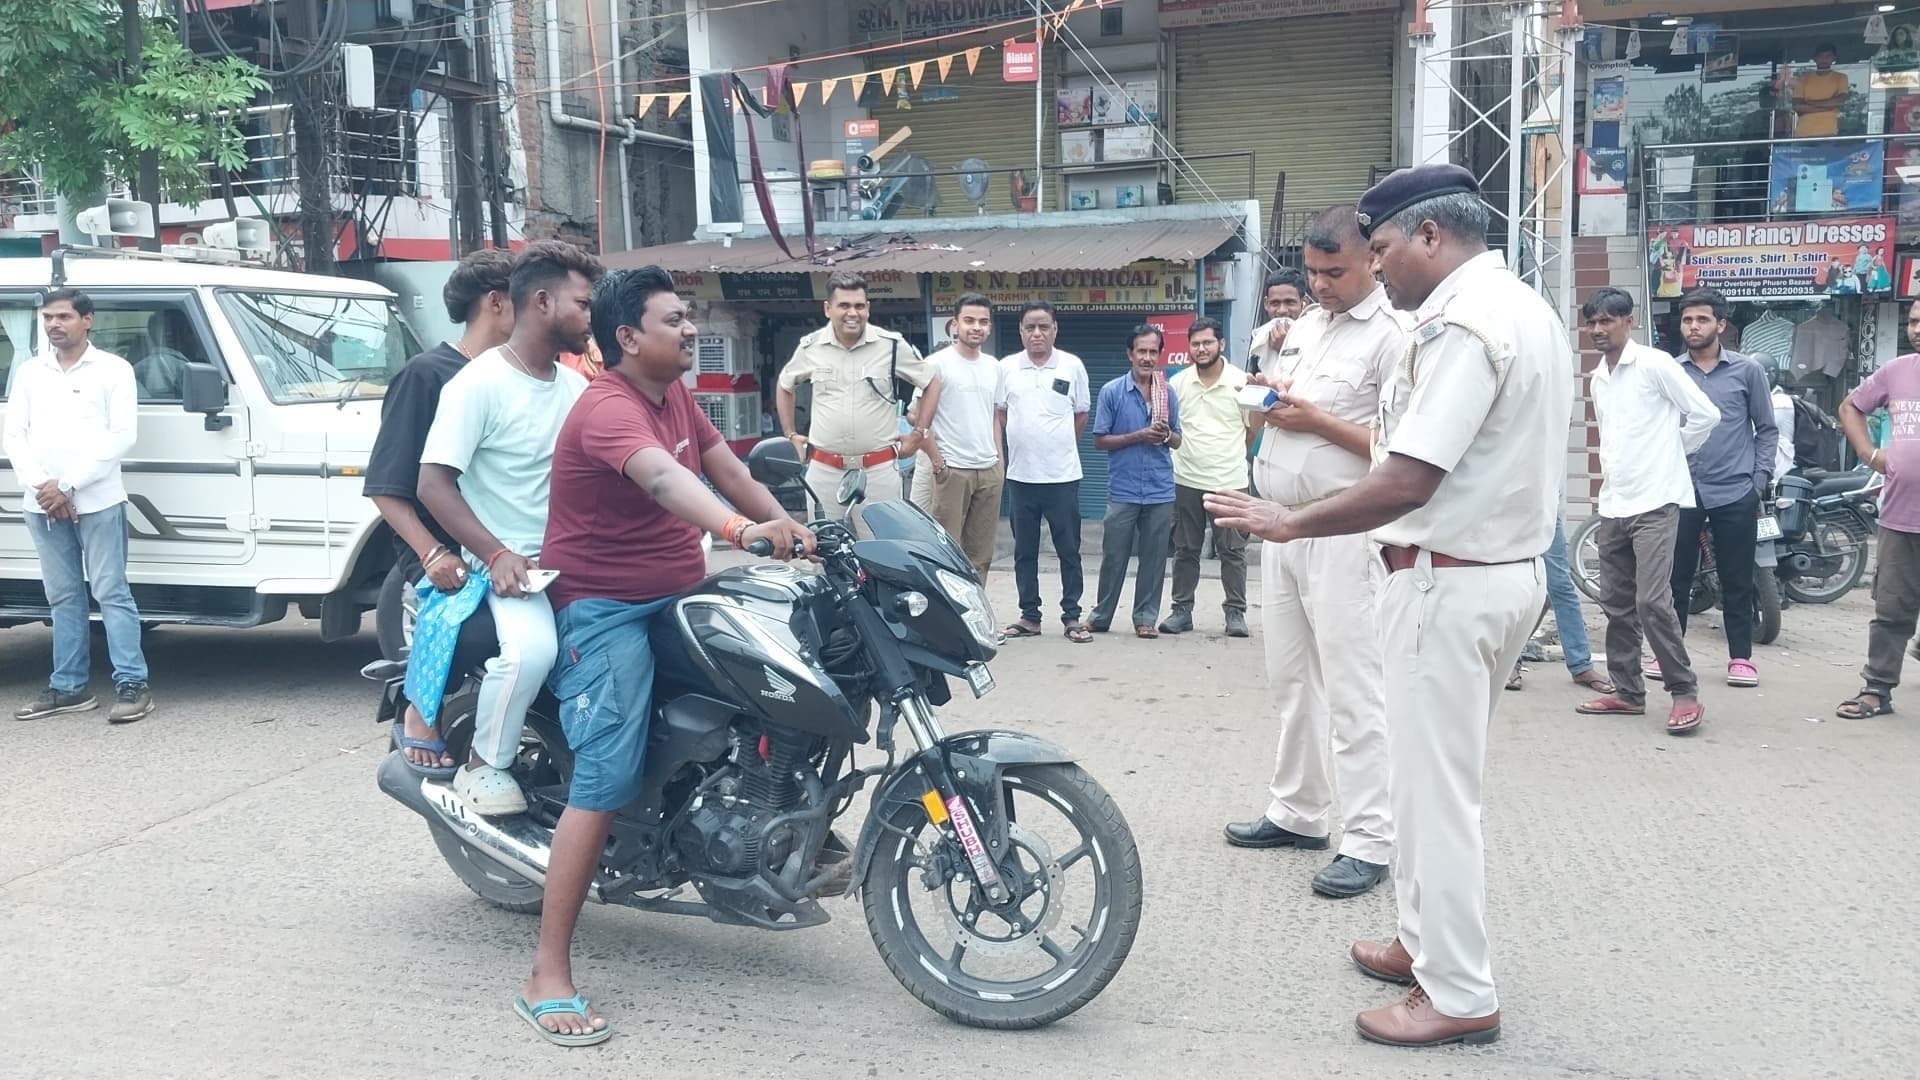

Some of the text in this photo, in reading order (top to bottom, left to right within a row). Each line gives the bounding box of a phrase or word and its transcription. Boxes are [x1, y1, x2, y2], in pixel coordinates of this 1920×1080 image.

[1693, 222, 1886, 248] Neha Fancy Dresses
[1717, 255, 1753, 265] Sarees
[1760, 253, 1786, 263] Shirt
[1793, 252, 1828, 262] T-shirt
[863, 271, 902, 283] CHOR
[1696, 265, 1818, 278] Jeans & All Readymade
[674, 275, 704, 286] HOR
[1017, 269, 1160, 290] ELECTRICAL
[1724, 280, 1761, 288] Overbridge
[1789, 278, 1812, 286] Bazaar
[866, 286, 893, 294] sonic
[1055, 303, 1083, 312] KARO
[1086, 303, 1156, 312] (JHARKHAND)
[1158, 302, 1195, 312] 829144
[760, 689, 796, 703] HONDA
